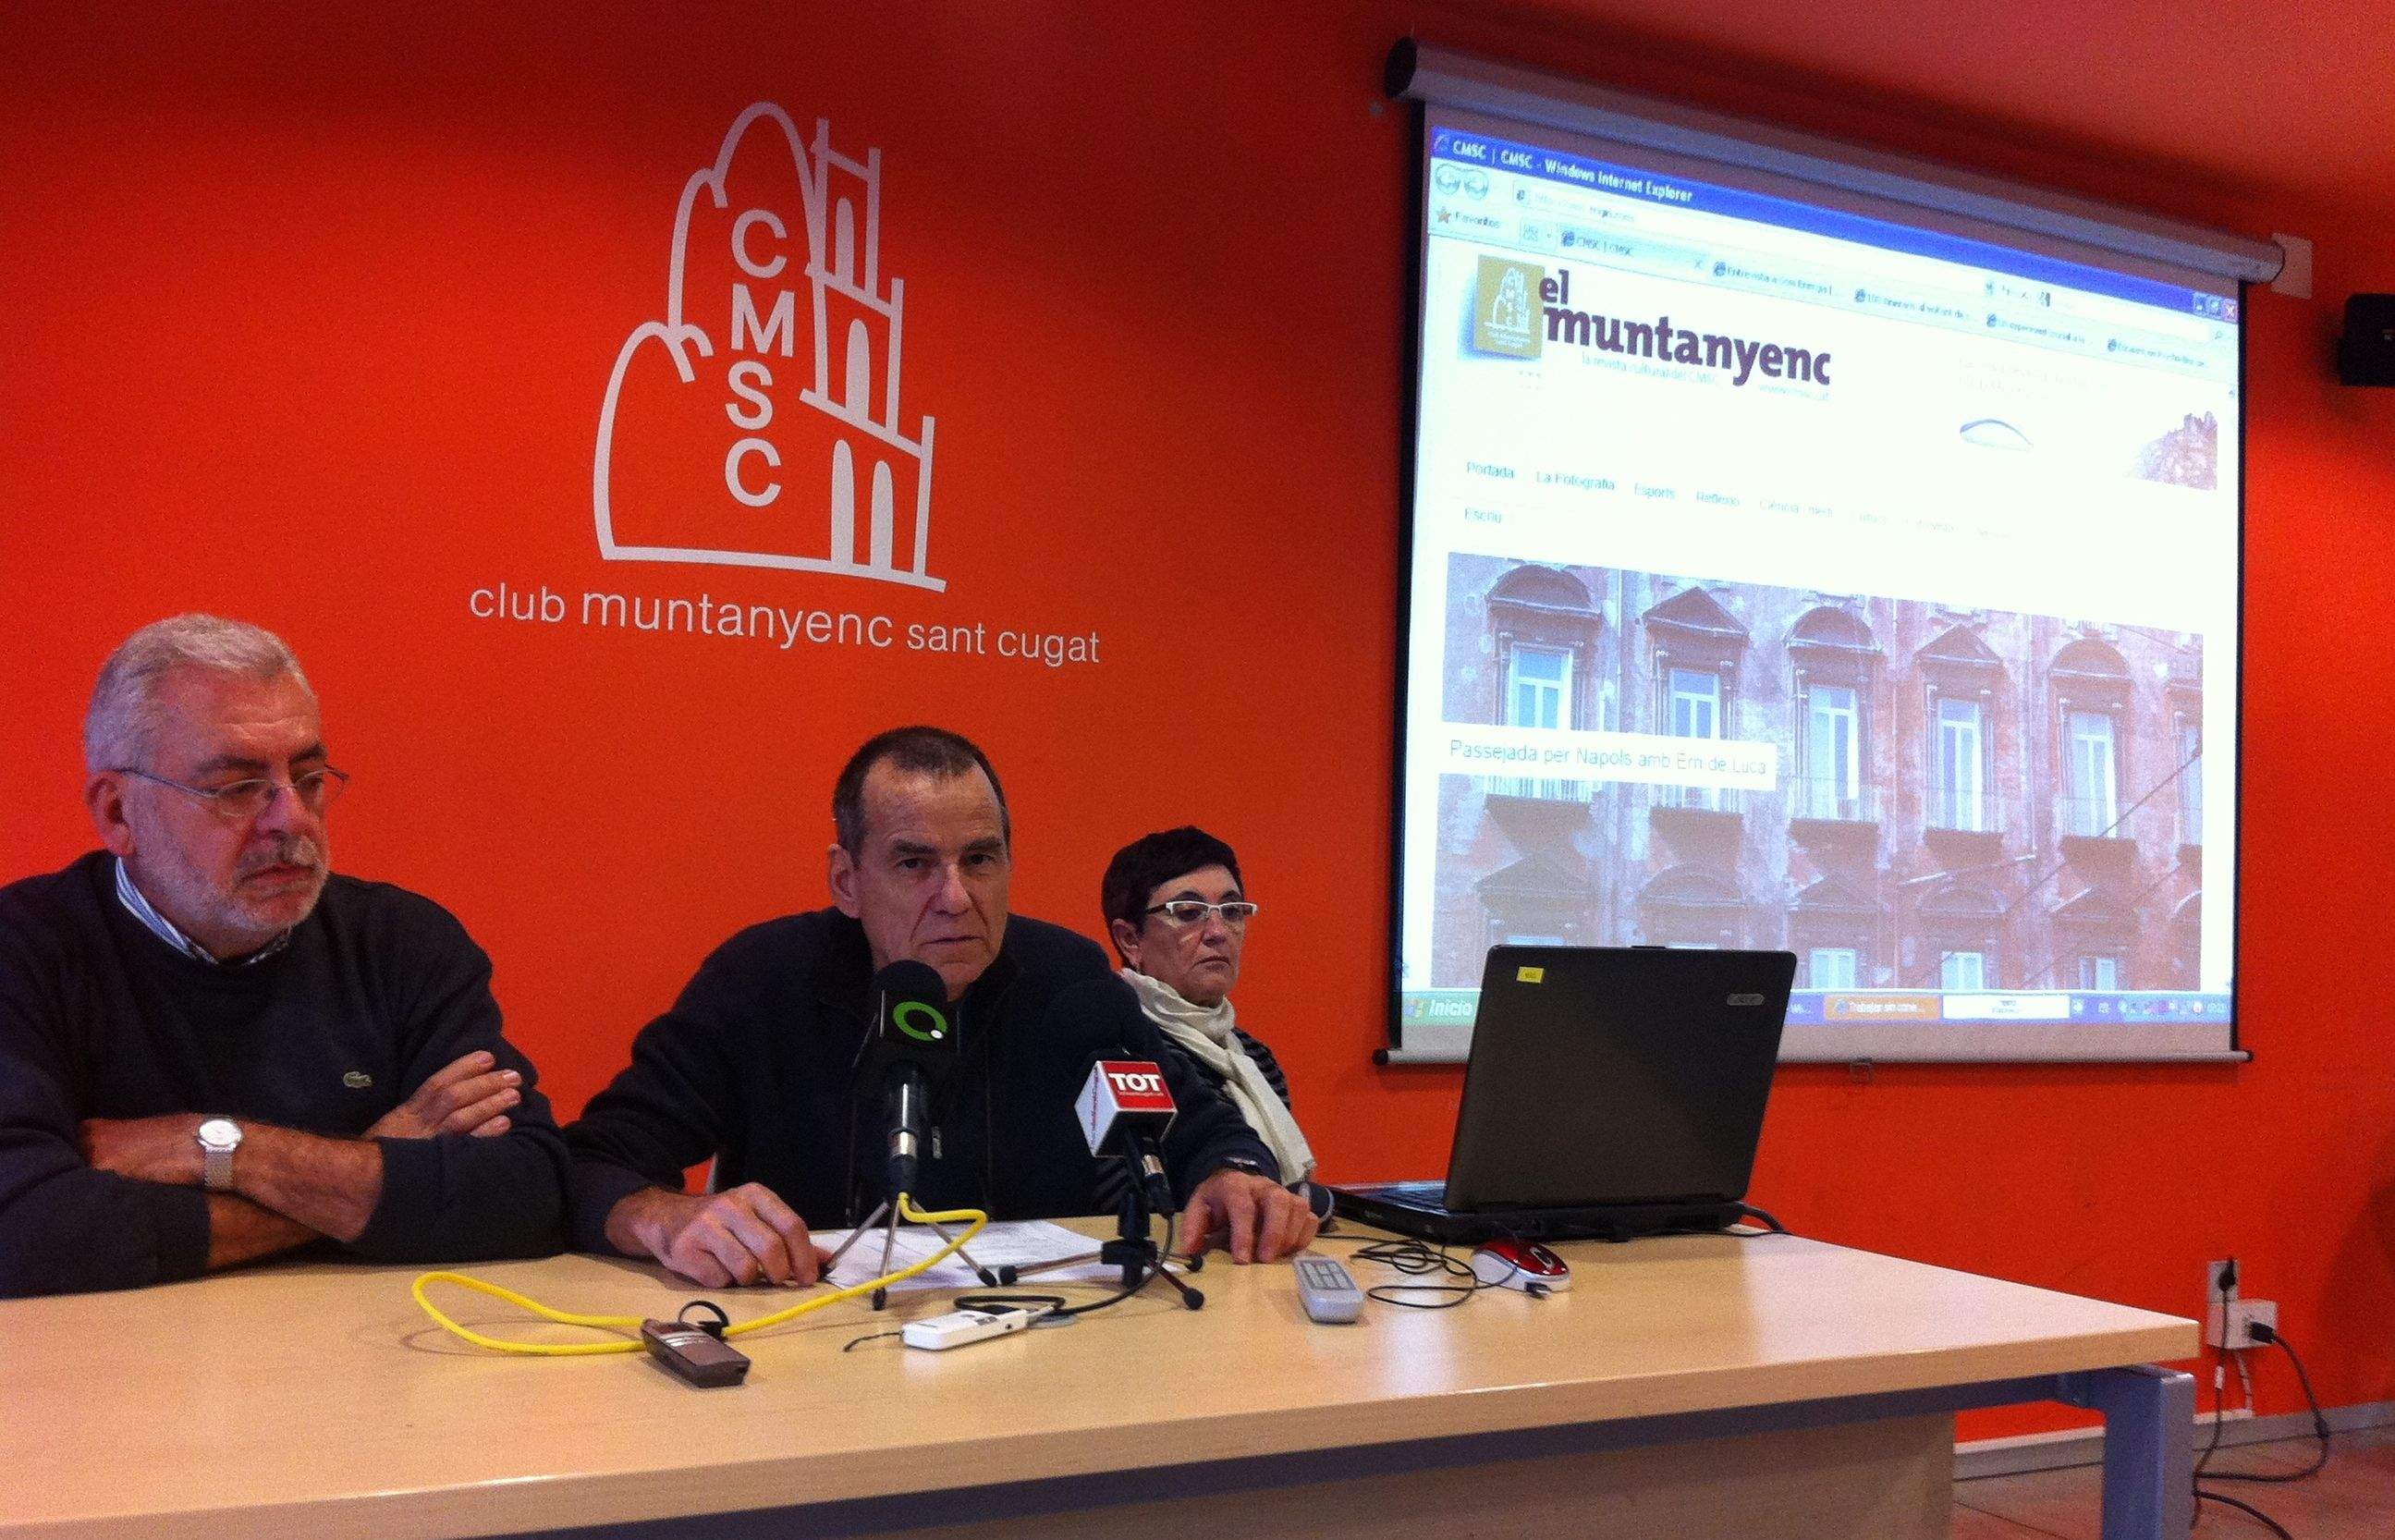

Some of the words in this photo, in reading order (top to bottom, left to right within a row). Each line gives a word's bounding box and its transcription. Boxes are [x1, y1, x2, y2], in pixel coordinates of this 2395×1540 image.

[1452, 141, 1487, 160] CMSC
[1500, 149, 1534, 169] CMSC
[1545, 158, 1595, 183] Windows
[1597, 171, 1644, 193] Internet
[1645, 180, 1693, 202] Explorer
[1538, 268, 1570, 305] el
[1543, 306, 1832, 386] muntanyenc
[1466, 460, 1516, 481] Portada
[1536, 471, 1552, 483] La
[470, 582, 566, 623] club
[582, 592, 894, 650] muntanyenc
[907, 622, 985, 655] sant
[996, 631, 1100, 667] cugat
[1449, 739, 1538, 764] Passejada
[1544, 747, 1570, 765] per
[1638, 752, 1671, 769] amb
[1708, 755, 1727, 773] de
[1732, 756, 1766, 775] Luca
[1429, 998, 1473, 1017] Inicio
[1107, 1072, 1161, 1093] TOT
